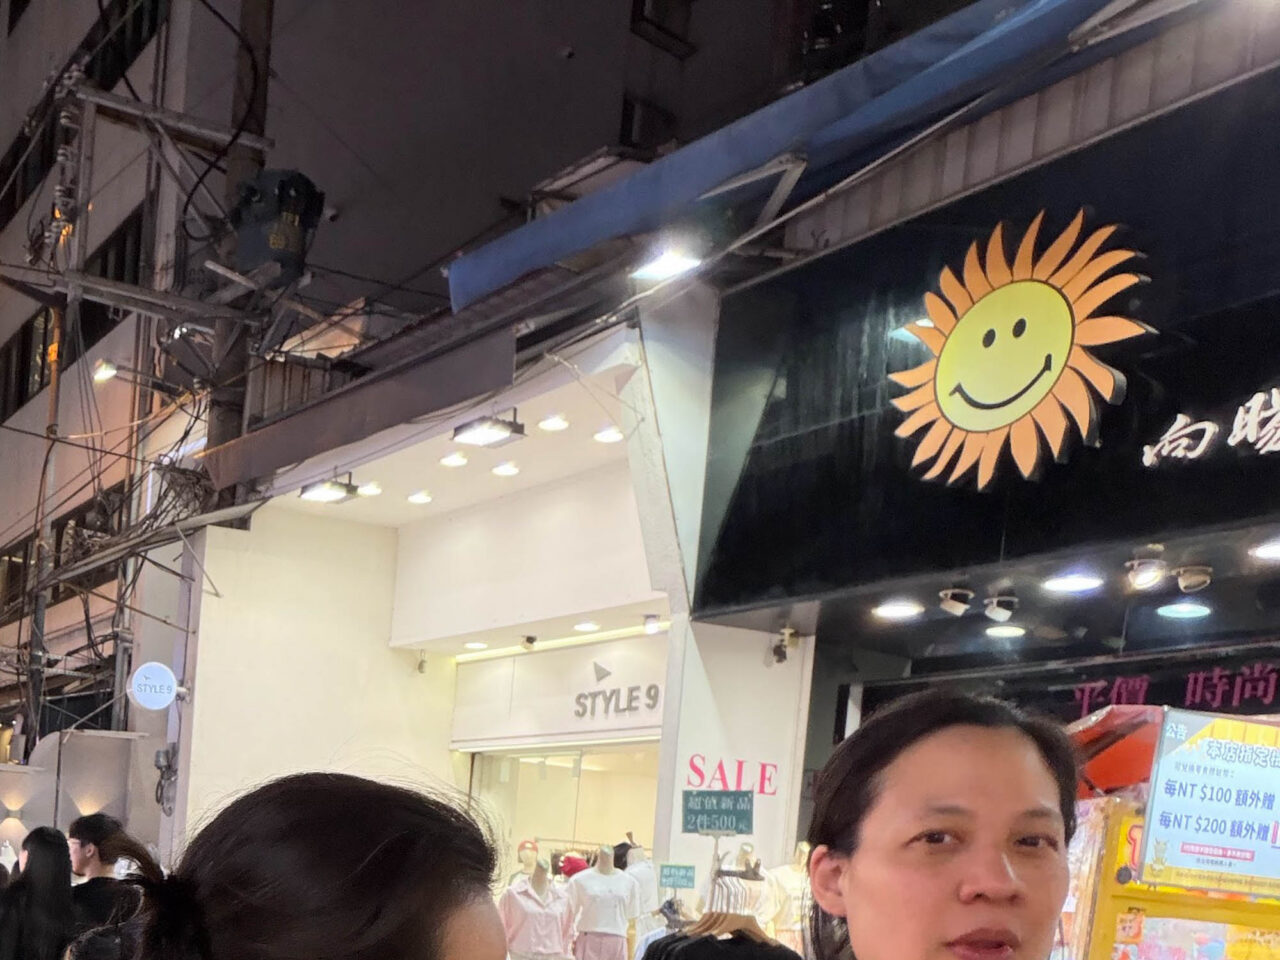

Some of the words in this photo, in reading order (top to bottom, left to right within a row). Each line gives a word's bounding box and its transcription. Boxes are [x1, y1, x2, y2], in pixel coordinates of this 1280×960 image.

[136, 683, 165, 694] STYLE
[167, 685, 172, 694] 9
[1184, 661, 1279, 709] 時尚
[574, 685, 641, 718] STYLE
[645, 683, 659, 710] 9
[1165, 722, 1189, 740] 公告
[687, 753, 778, 796] SALE
[1200, 784, 1232, 804] $100
[1194, 815, 1227, 835] $200
